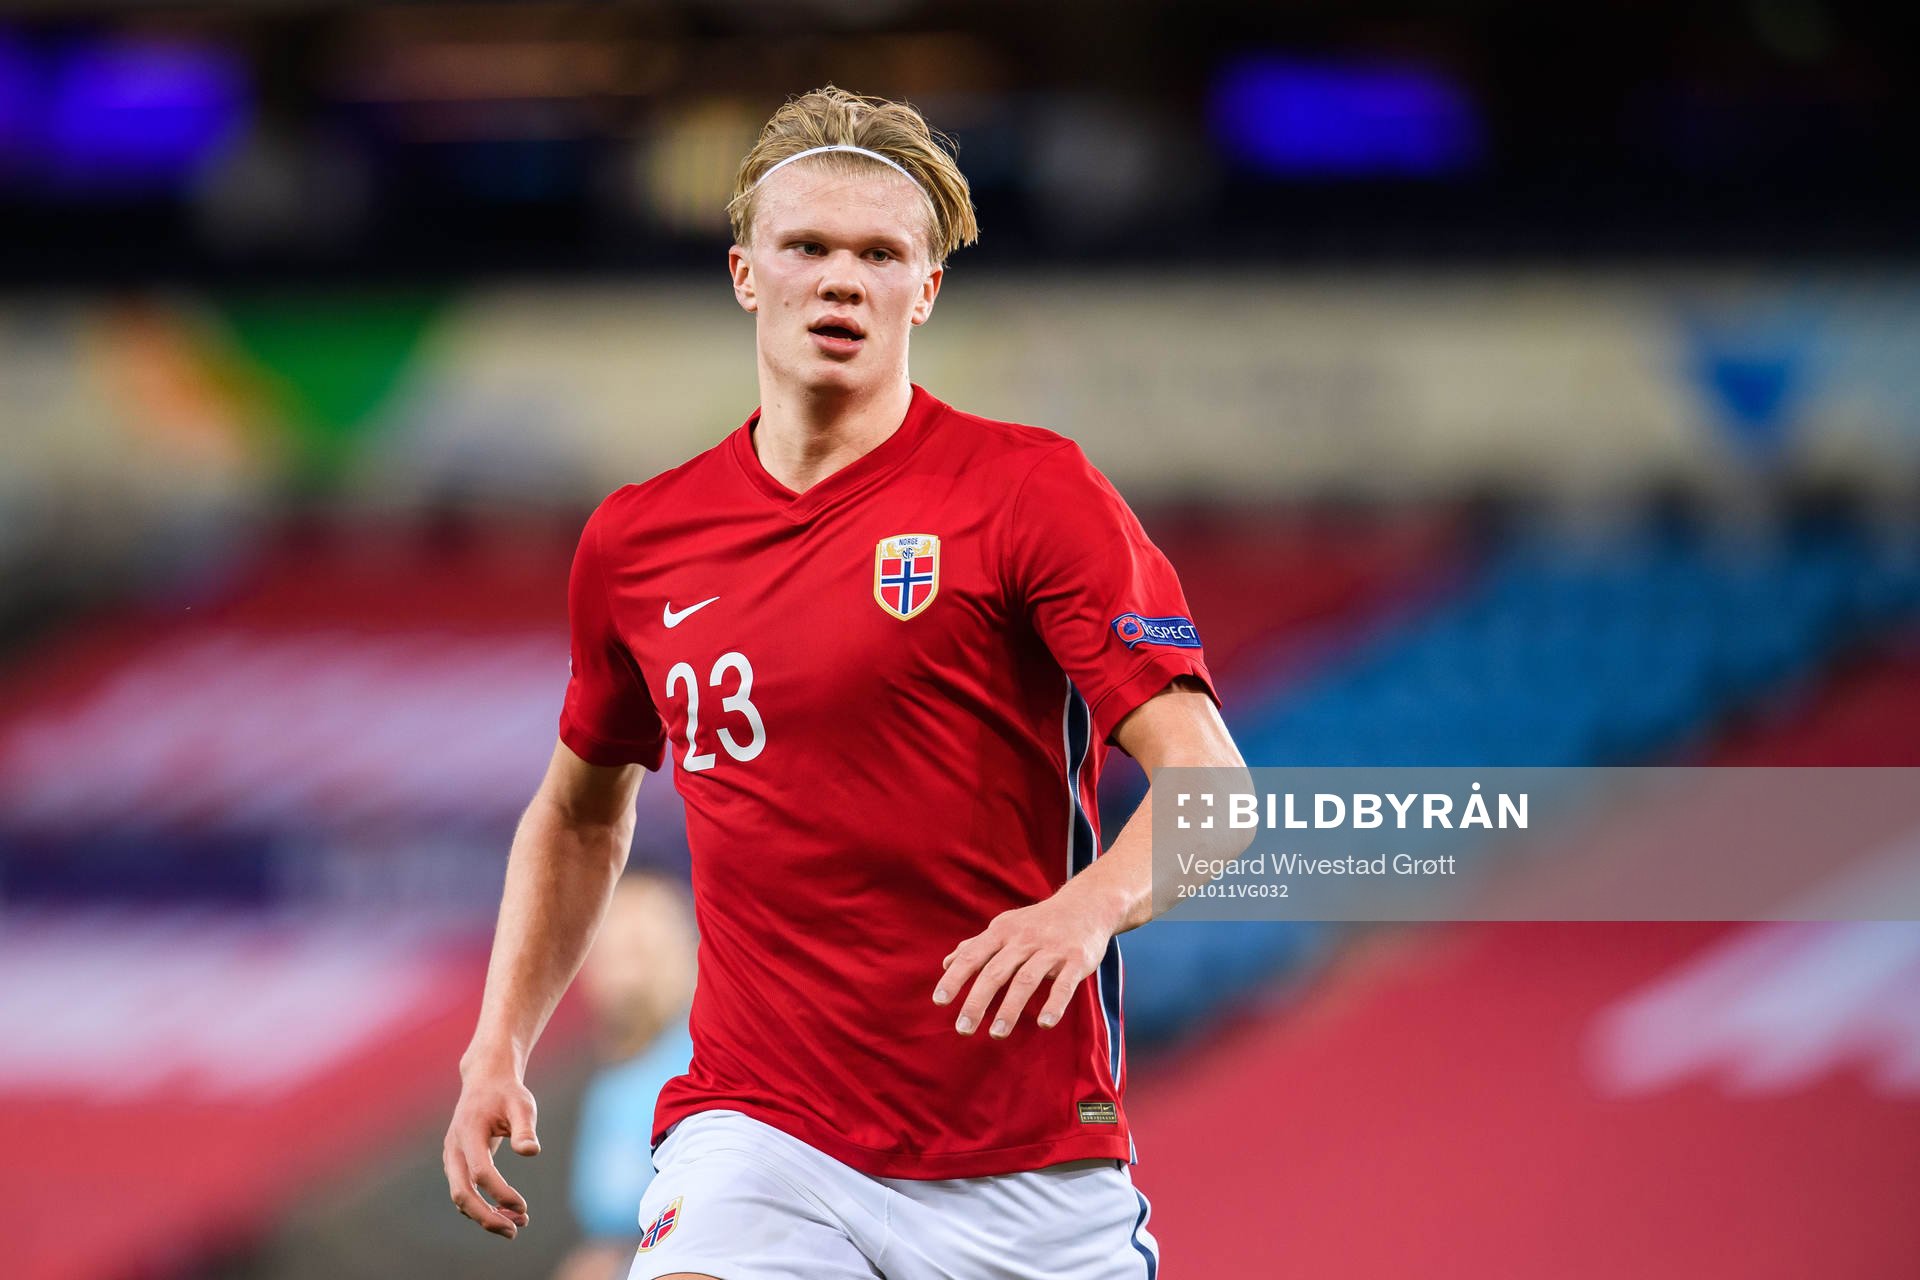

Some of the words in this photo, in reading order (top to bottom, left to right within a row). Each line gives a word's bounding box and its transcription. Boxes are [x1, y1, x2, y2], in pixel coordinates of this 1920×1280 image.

[899, 537, 919, 546] NORGE
[1141, 622, 1197, 640] RESPECT
[665, 651, 767, 773] 23
